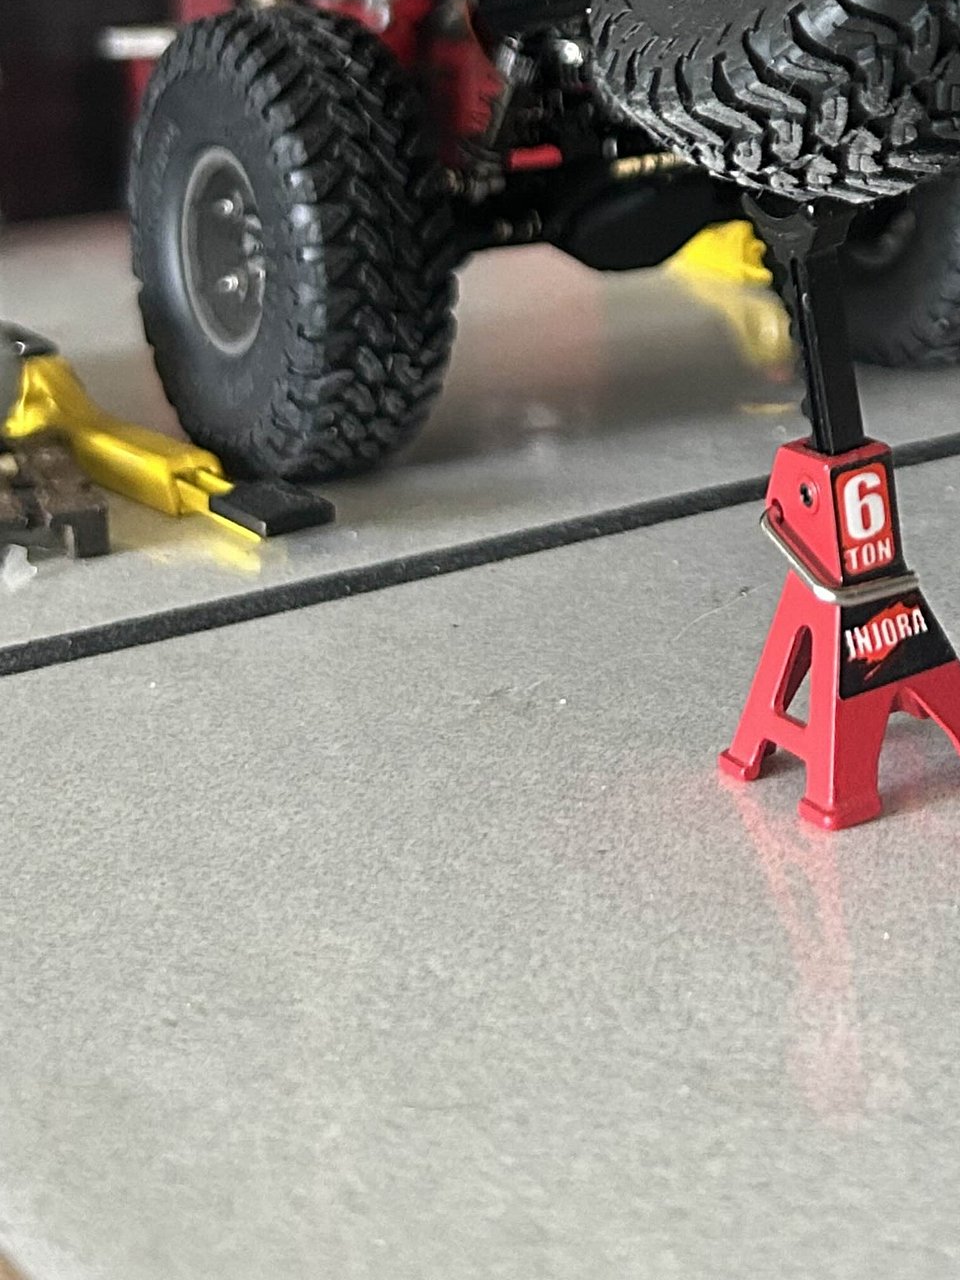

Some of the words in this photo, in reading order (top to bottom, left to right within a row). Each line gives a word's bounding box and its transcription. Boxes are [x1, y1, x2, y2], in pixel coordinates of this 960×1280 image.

[843, 472, 886, 540] 6
[845, 538, 893, 570] TON
[845, 607, 929, 659] INJORA
